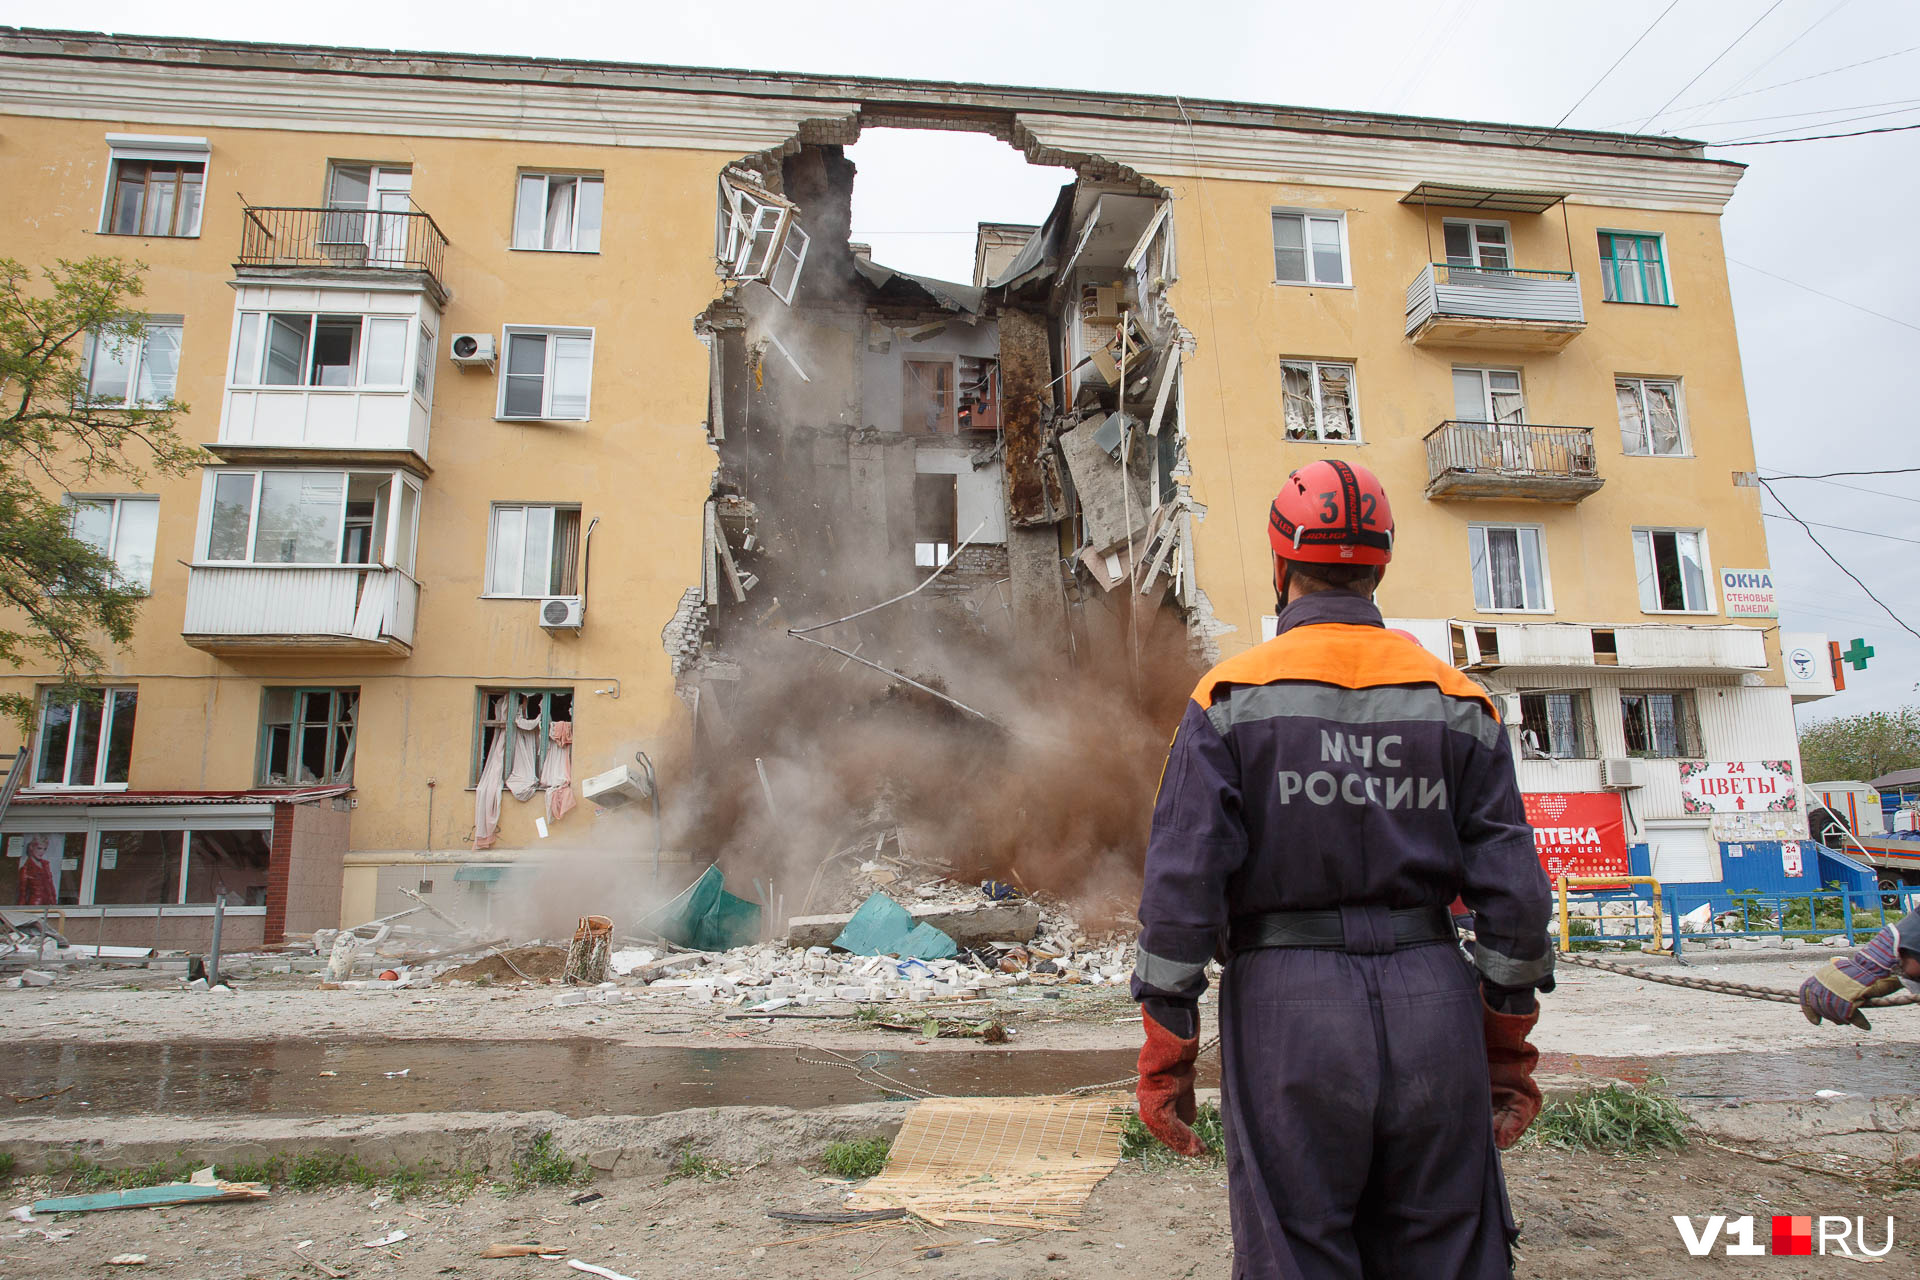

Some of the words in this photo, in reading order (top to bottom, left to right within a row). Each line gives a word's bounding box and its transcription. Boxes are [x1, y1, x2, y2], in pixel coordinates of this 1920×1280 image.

[1342, 470, 1354, 483] LED
[1320, 491, 1338, 524] 3
[1361, 493, 1376, 525] 2
[1725, 573, 1773, 588] ОКНА
[1726, 593, 1774, 602] СТЕНОВЫЕ
[1734, 604, 1769, 613] ПАНЕЛИ
[1320, 729, 1402, 768] МЧС
[1727, 761, 1745, 774] 24
[1278, 771, 1447, 810] РОССИИ
[1700, 777, 1776, 797] ЦВЕТЫ
[1533, 827, 1600, 845] ПТЕКА
